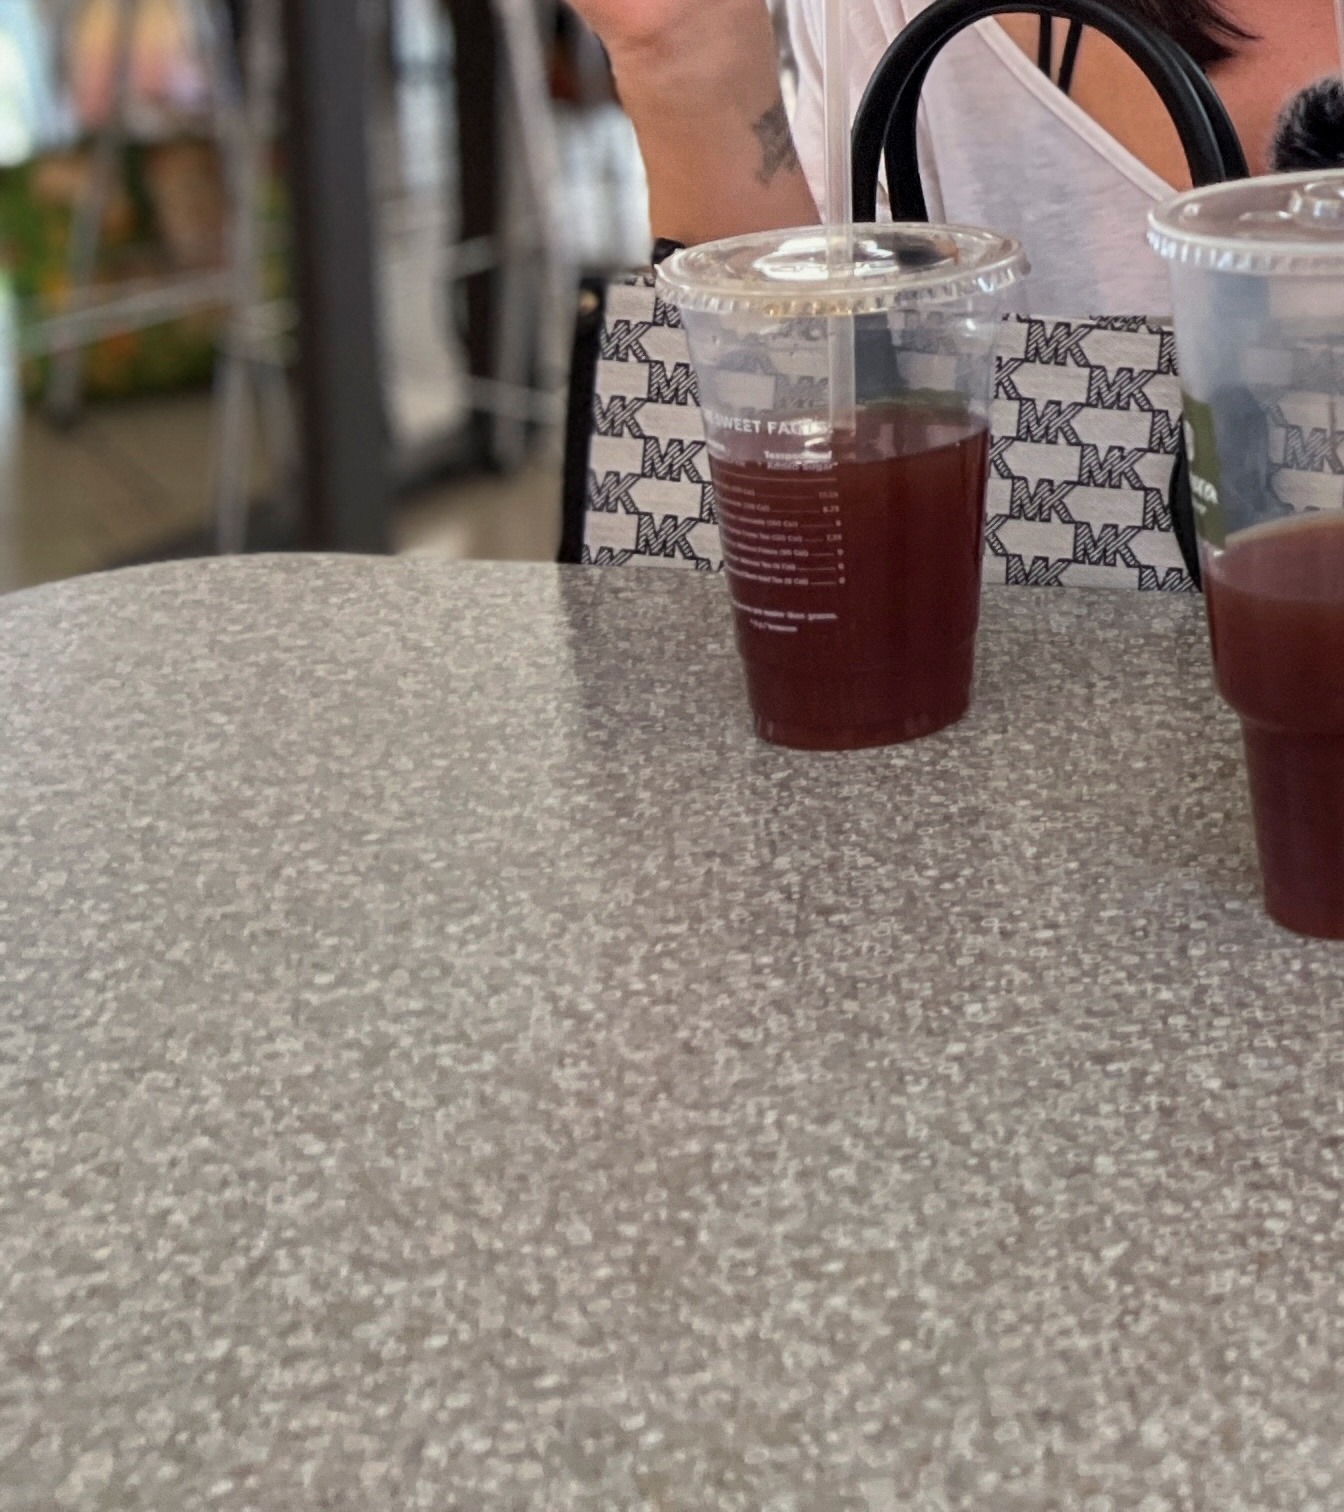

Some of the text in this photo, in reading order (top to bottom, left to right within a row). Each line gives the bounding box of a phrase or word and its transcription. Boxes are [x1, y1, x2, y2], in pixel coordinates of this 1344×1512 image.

[1025, 320, 1097, 367] MK
[1086, 366, 1157, 412] MK
[1016, 398, 1087, 445] MK
[641, 436, 706, 483] MK
[1078, 444, 1149, 489] MK
[1009, 476, 1080, 524] MK
[637, 511, 701, 560] MK
[1072, 521, 1143, 568] MK
